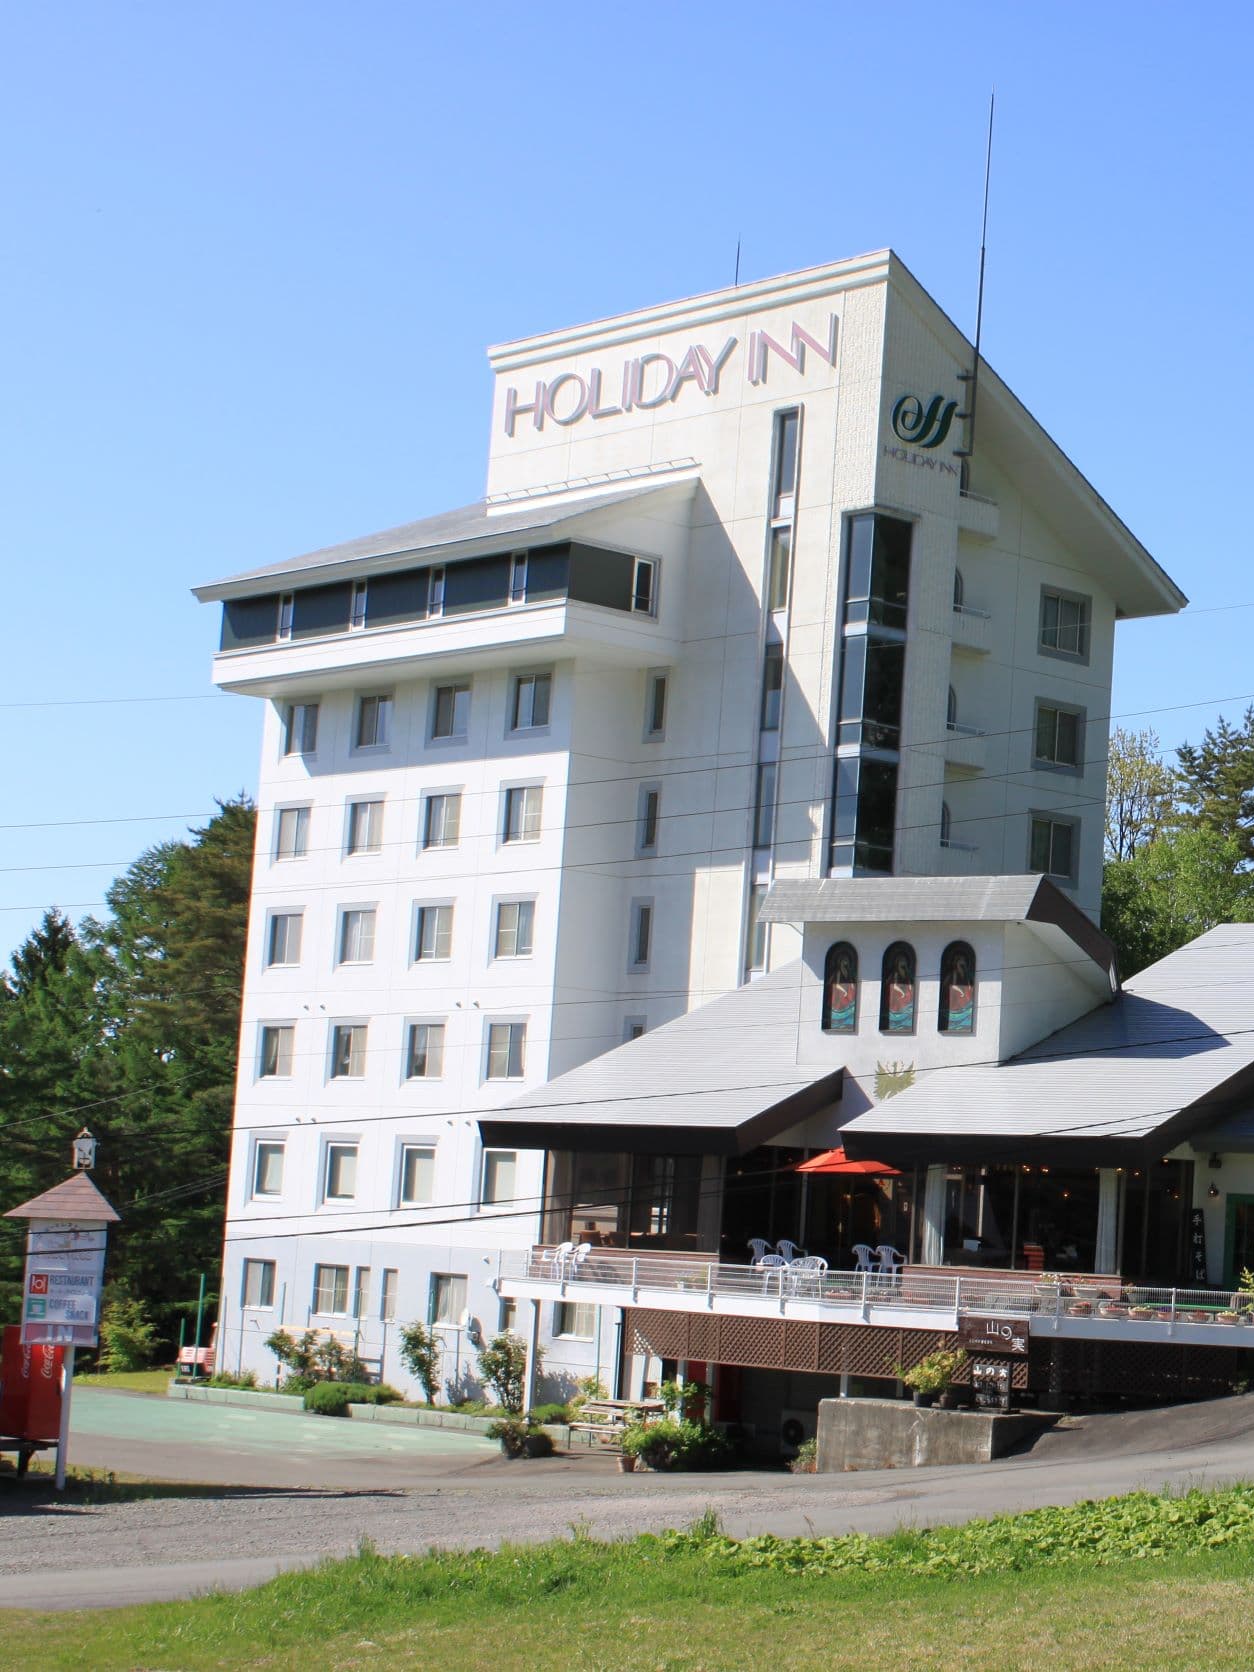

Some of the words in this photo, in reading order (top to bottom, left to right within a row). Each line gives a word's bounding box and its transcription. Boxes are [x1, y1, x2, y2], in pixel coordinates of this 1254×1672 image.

[504, 336, 738, 437] HOLIDAY
[748, 312, 839, 386] INN
[986, 1320, 1025, 1352] 山の実
